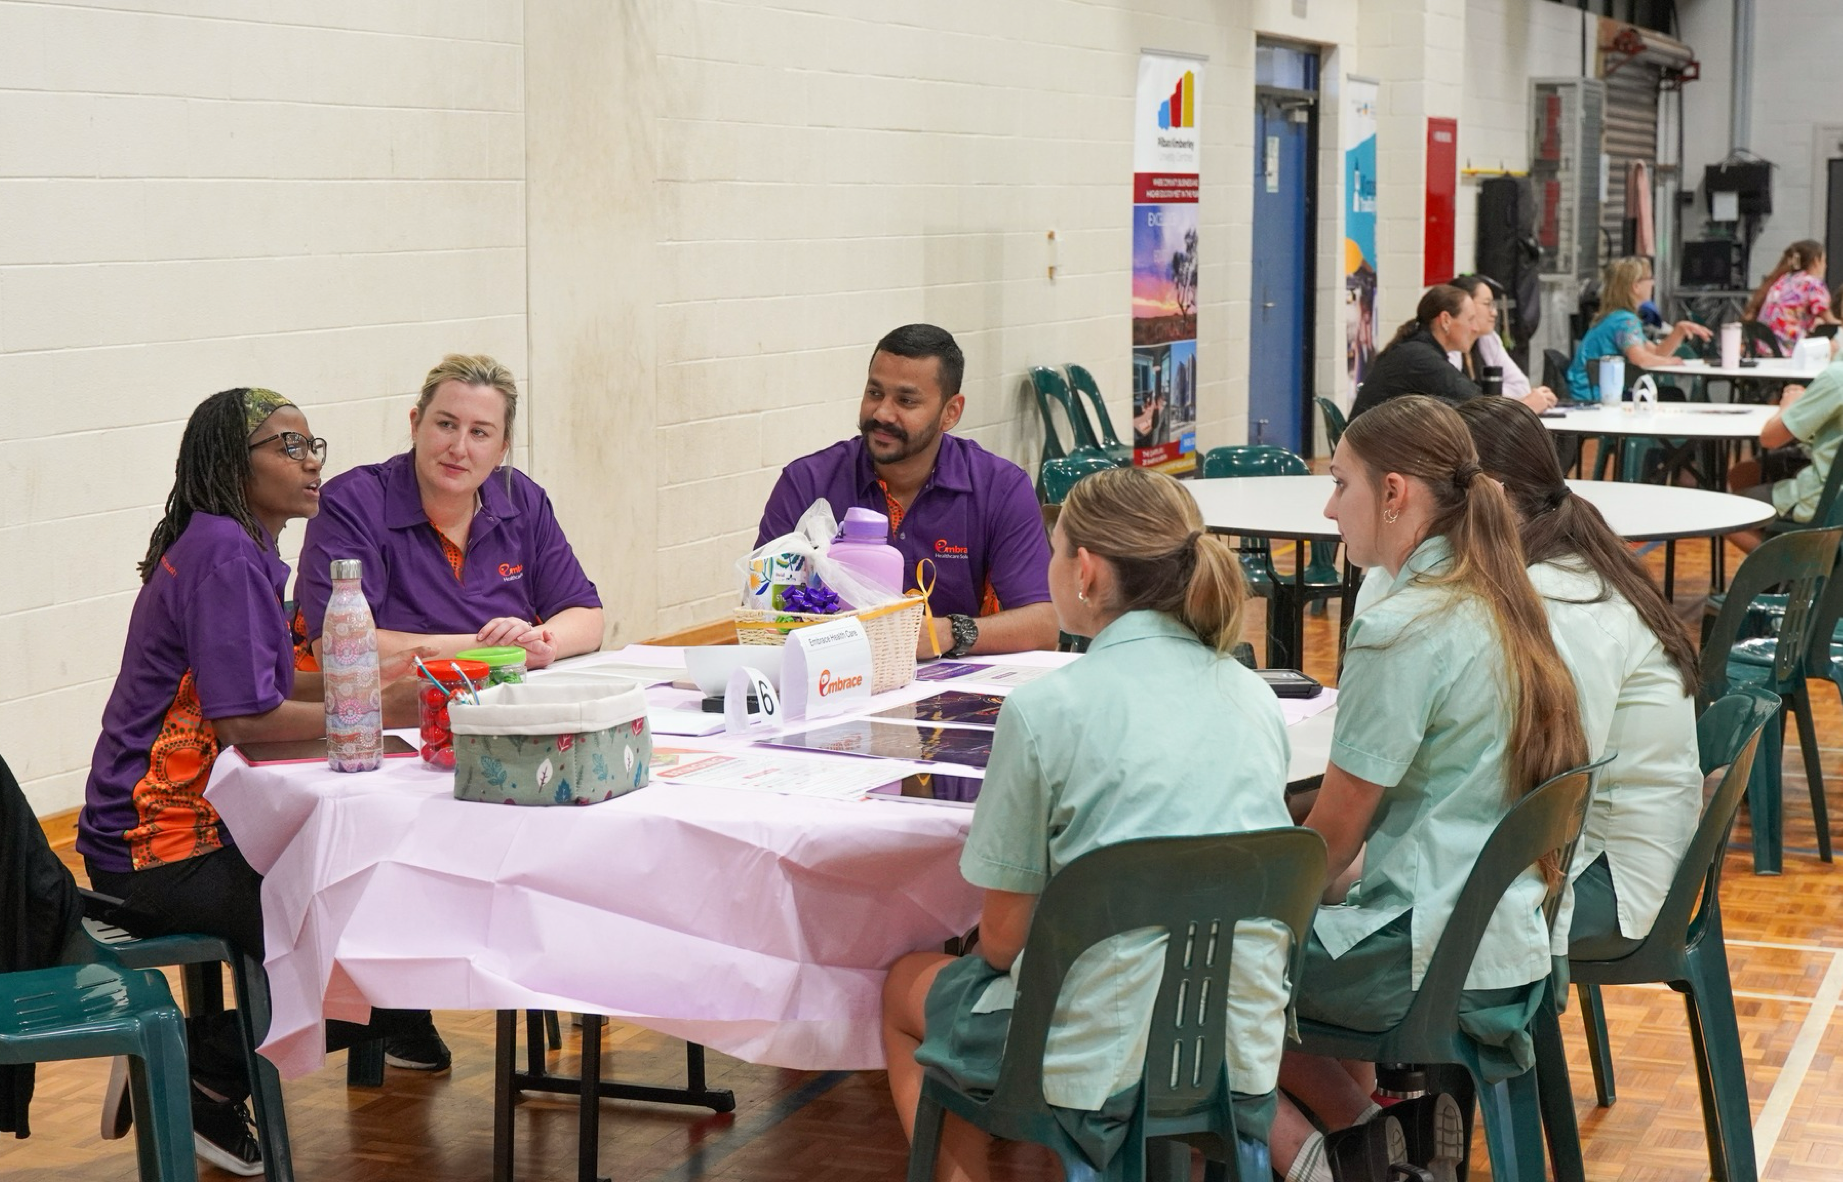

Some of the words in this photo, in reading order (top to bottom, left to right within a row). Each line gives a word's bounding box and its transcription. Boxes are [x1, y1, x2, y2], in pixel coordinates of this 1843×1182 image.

[934, 539, 968, 553] embra
[808, 636, 830, 646] Embrace
[830, 632, 845, 642] Health
[845, 629, 858, 638] Care
[758, 679, 775, 716] 6
